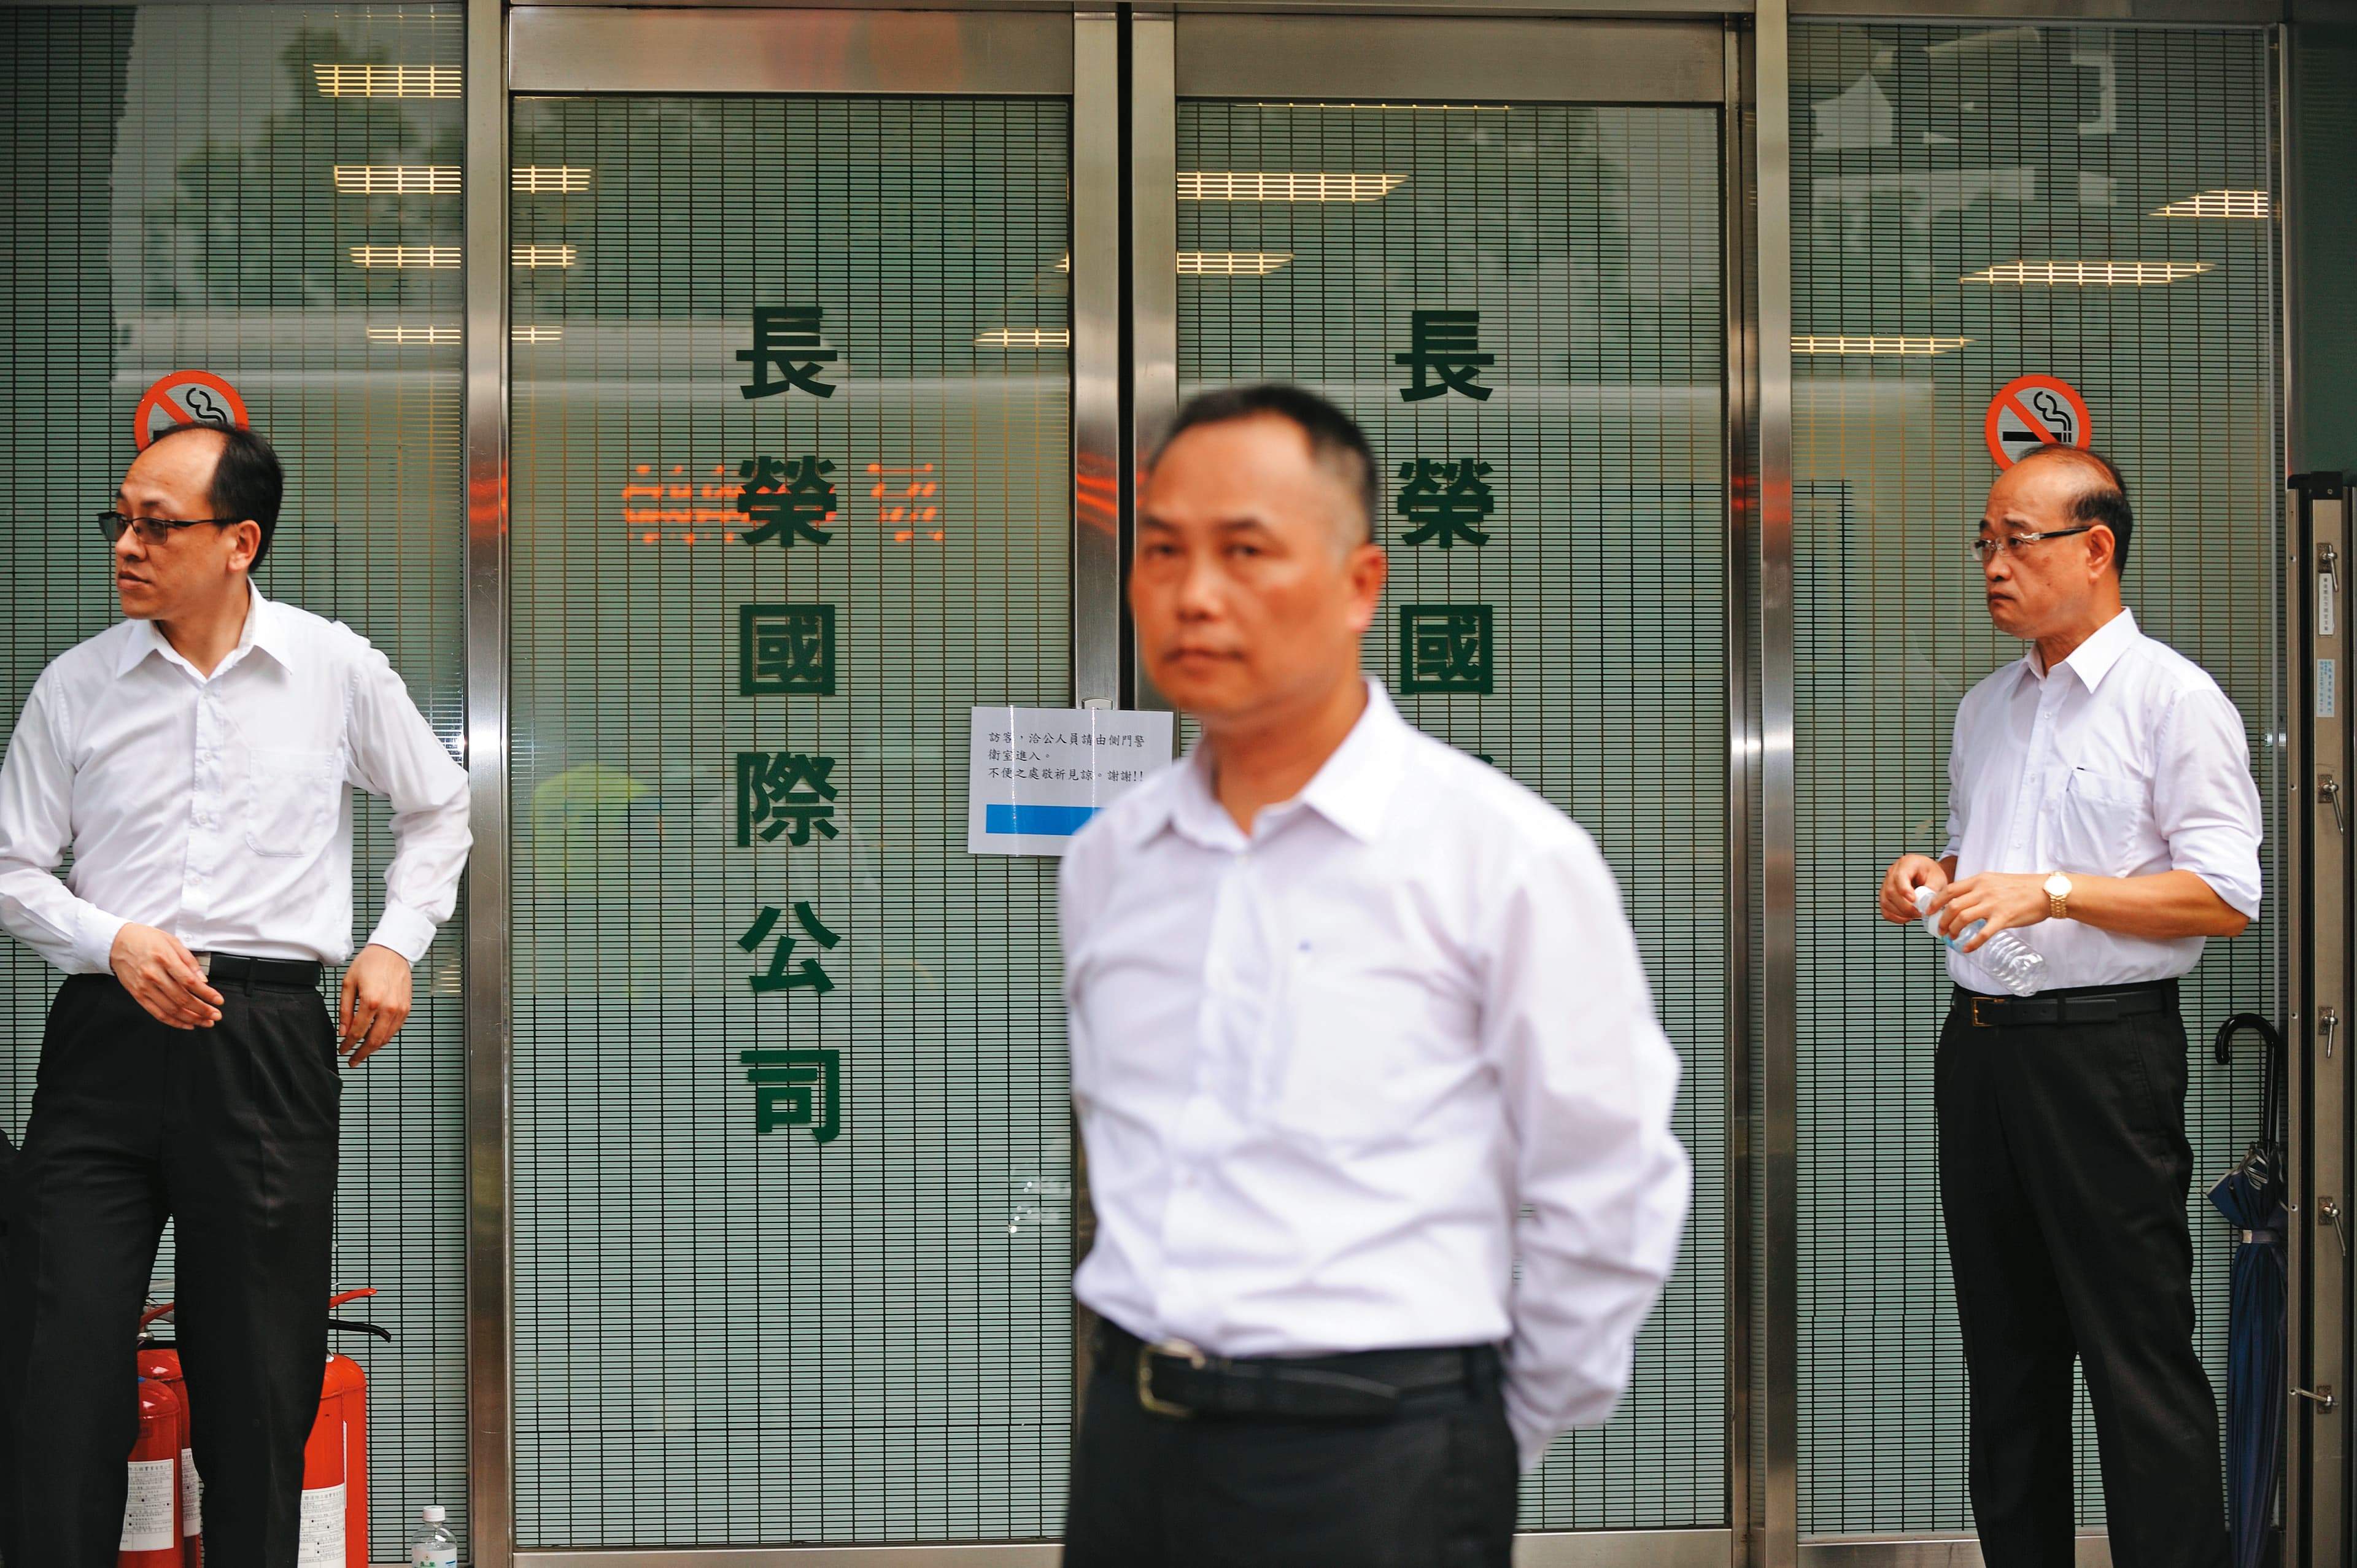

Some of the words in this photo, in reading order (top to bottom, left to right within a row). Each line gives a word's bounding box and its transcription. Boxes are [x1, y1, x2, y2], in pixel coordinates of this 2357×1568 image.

[736, 306, 842, 1144] 長榮國際公司
[988, 749, 1050, 761] 衛室進入。
[1395, 310, 1495, 765] 長榮國
